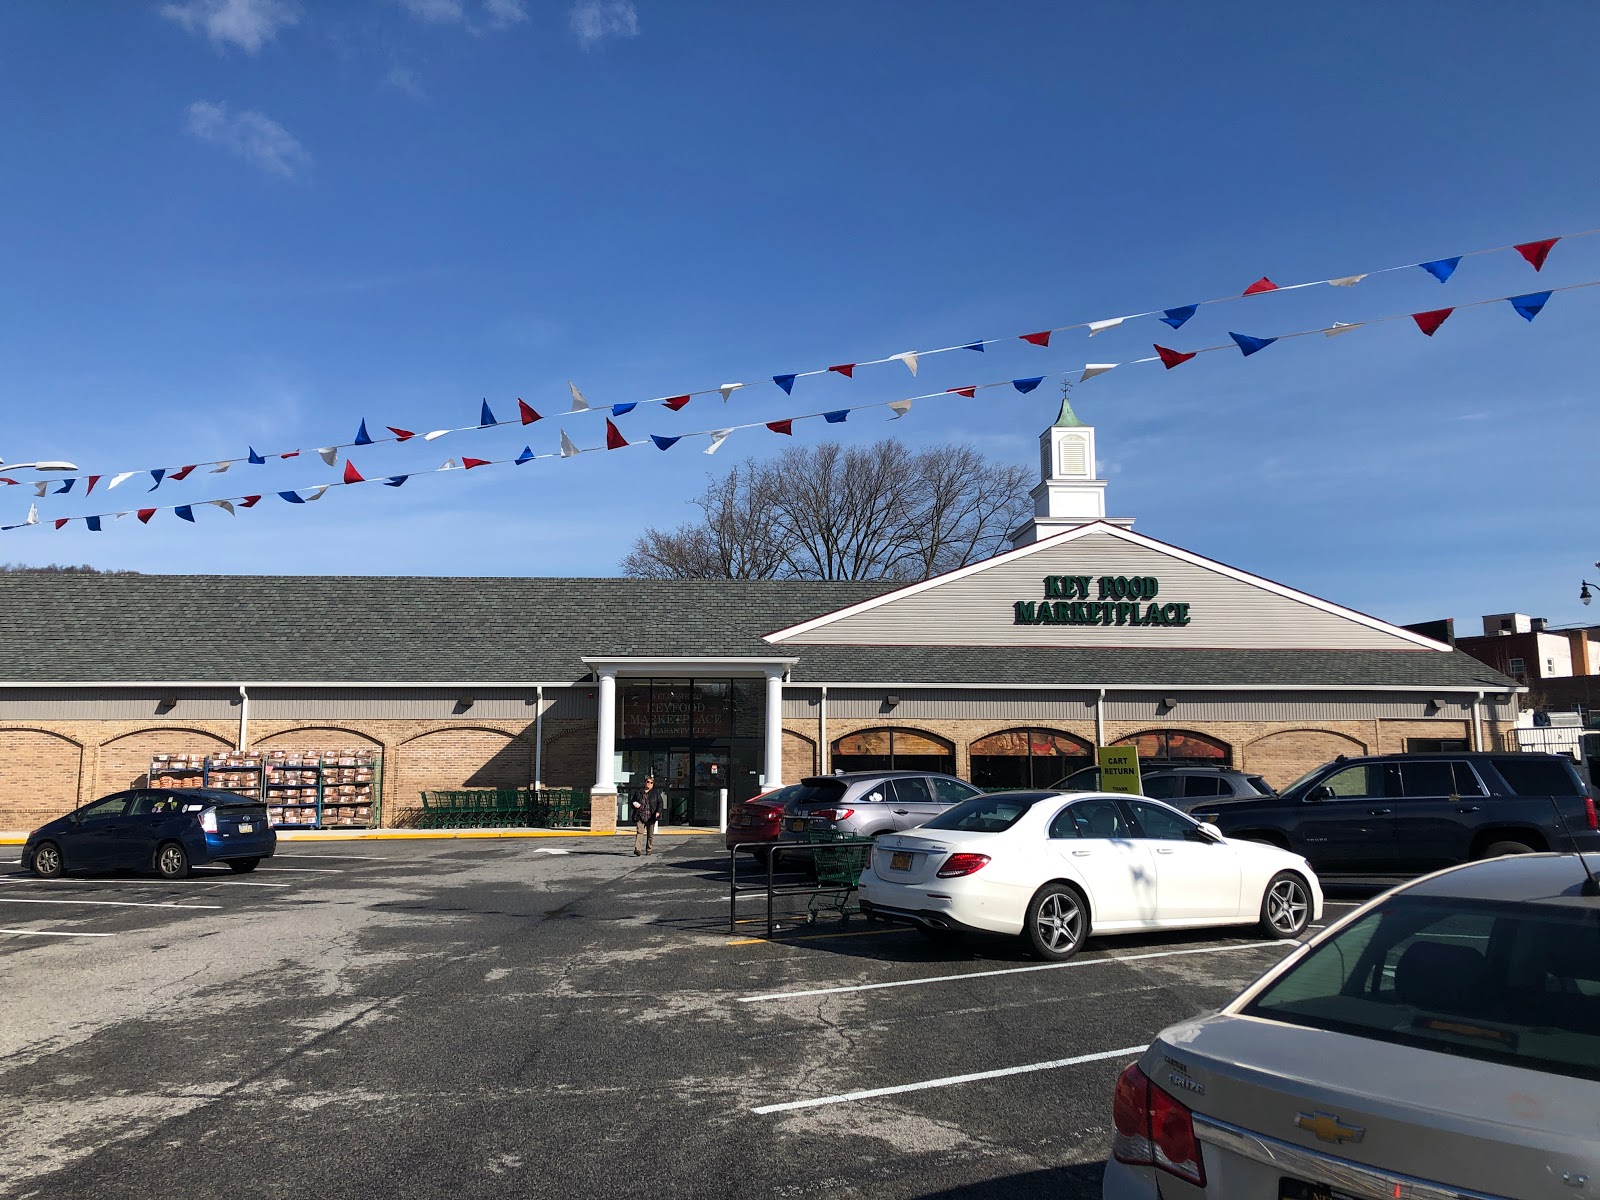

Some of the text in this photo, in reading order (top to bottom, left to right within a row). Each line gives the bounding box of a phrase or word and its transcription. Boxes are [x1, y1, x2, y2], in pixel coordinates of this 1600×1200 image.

[1043, 575, 1159, 601] KEY FOOD
[1012, 600, 1192, 627] MARKETPLACE
[1104, 767, 1135, 775] RETURN
[1108, 757, 1128, 765] CART
[1168, 1073, 1206, 1097] CRUZE
